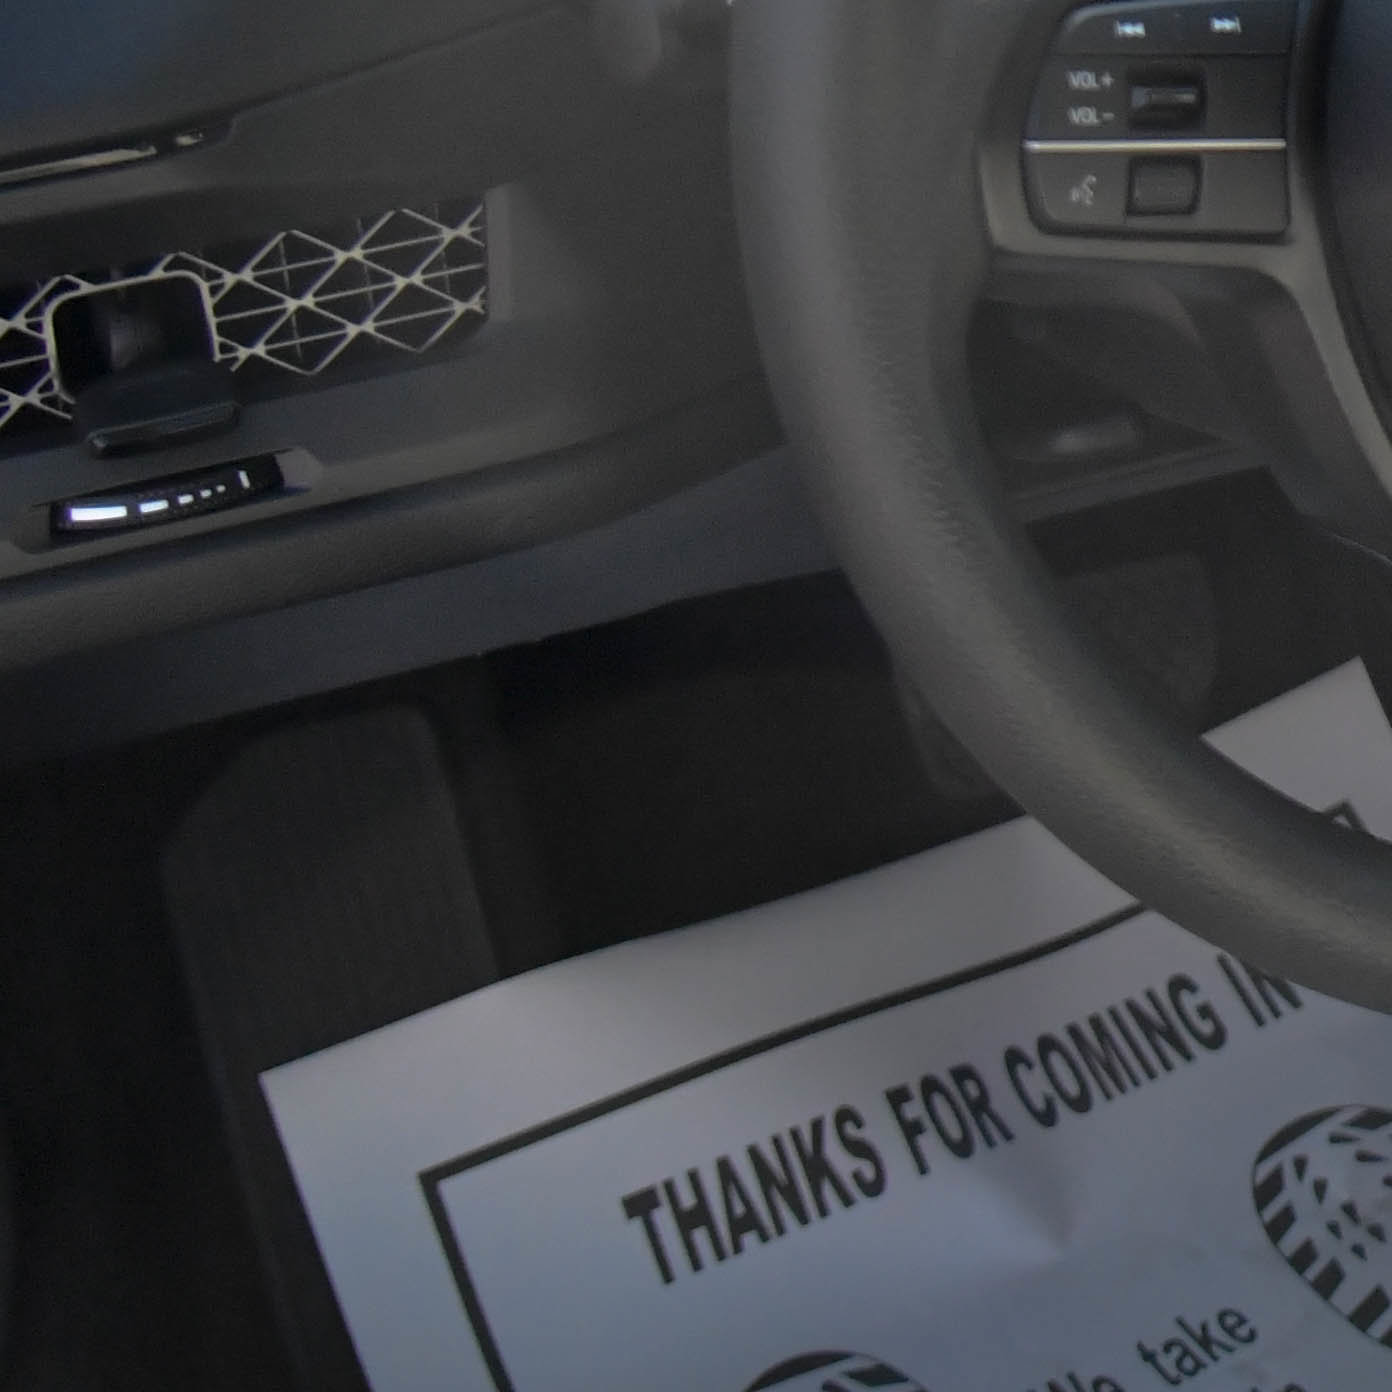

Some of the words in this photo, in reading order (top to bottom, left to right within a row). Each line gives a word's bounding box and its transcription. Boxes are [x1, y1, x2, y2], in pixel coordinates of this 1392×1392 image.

[619, 1102, 887, 1286] THANKS
[885, 1061, 1014, 1177] FOR
[1003, 974, 1227, 1130] COMING
[1136, 1307, 1257, 1386] take
